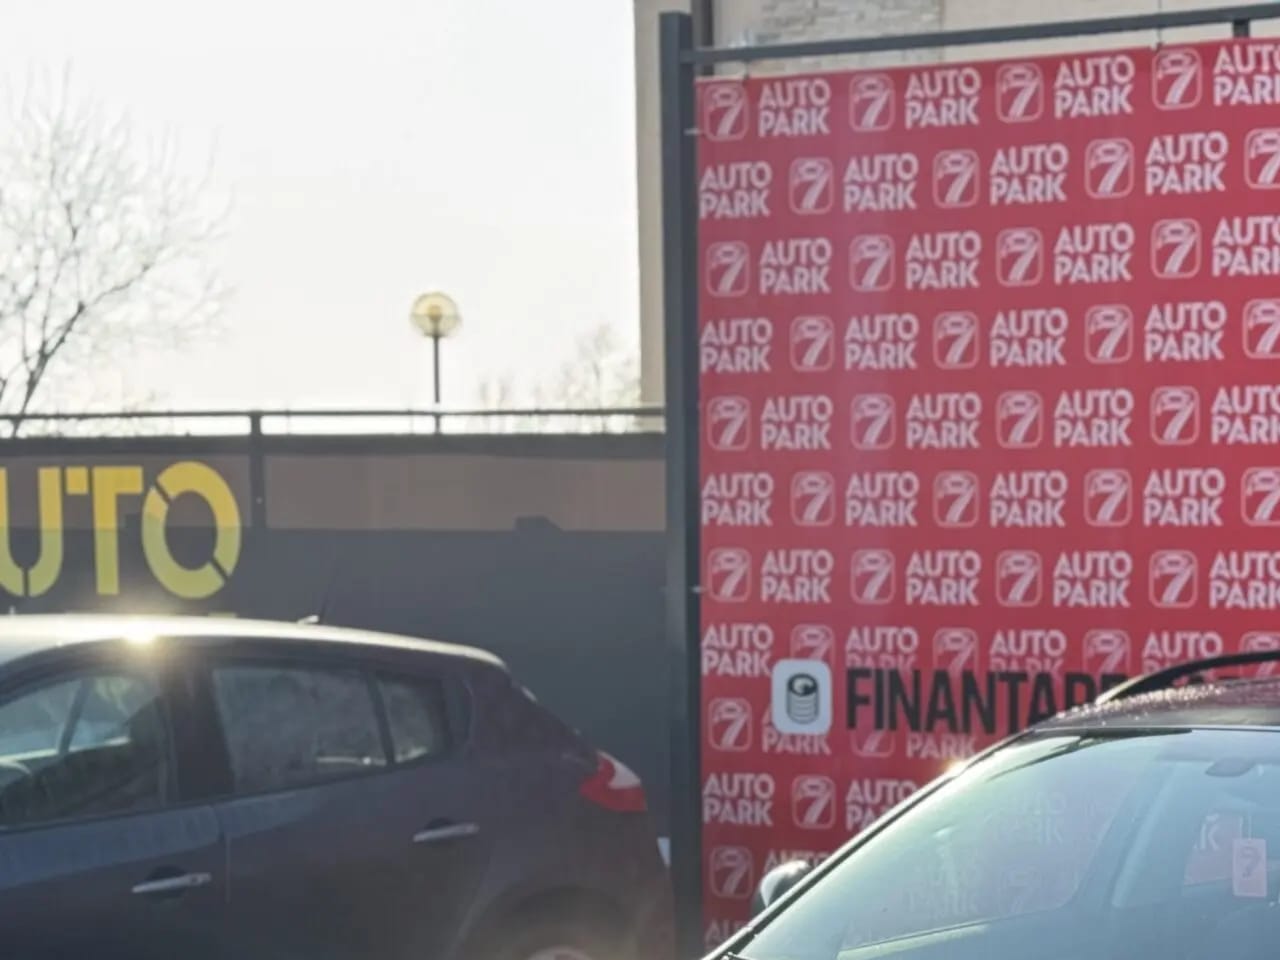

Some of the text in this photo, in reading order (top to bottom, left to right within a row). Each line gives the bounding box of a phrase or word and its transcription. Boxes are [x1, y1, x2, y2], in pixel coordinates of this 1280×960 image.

[904, 68, 980, 100] AUTO
[1054, 55, 1134, 89] AUTO
[757, 79, 830, 109] AUTO
[1055, 84, 1132, 118] PARK
[759, 106, 829, 137] PARK
[906, 96, 978, 128] PARK
[990, 143, 1068, 176] AUTO
[1146, 132, 1228, 165] AUTO
[699, 161, 772, 192] AUTO
[844, 153, 918, 184] AUTO
[1146, 161, 1225, 194] PARK
[844, 180, 916, 212] PARK
[990, 173, 1066, 205] PARK
[699, 189, 770, 219] PARK
[760, 238, 832, 267] AUTO
[906, 231, 981, 262] AUTO
[1054, 223, 1134, 255] AUTO
[760, 265, 830, 294] PARK
[906, 259, 979, 289] PARK
[1055, 252, 1131, 284] PARK
[845, 313, 919, 343] AUTO
[991, 308, 1068, 338] AUTO
[1145, 301, 1226, 332] AUTO
[700, 318, 772, 346] AUTO
[1145, 330, 1224, 361] PARK
[700, 345, 770, 373] PARK
[845, 341, 916, 370] PARK
[990, 336, 1065, 366] PARK
[761, 395, 833, 423] AUTO
[906, 392, 981, 421] AUTO
[1055, 389, 1133, 419] AUTO
[761, 421, 830, 449] PARK
[907, 419, 979, 448] PARK
[1055, 417, 1131, 446] PARK
[702, 472, 773, 499] AUTO
[846, 472, 919, 499] AUTO
[990, 471, 1067, 499] AUTO
[1144, 468, 1225, 497] AUTO
[702, 499, 771, 525] PARK
[846, 499, 917, 526] PARK
[990, 499, 1065, 526] PARK
[1144, 497, 1222, 526] PARK
[762, 549, 833, 576] AUTO
[906, 550, 981, 577] AUTO
[1054, 551, 1132, 579] AUTO
[761, 576, 830, 602] PARK
[906, 577, 978, 605] PARK
[1054, 579, 1129, 607] PARK
[702, 624, 773, 650] AUTO
[846, 627, 918, 654] AUTO
[990, 630, 1067, 657] AUTO
[1142, 632, 1223, 660] AUTO
[702, 650, 773, 677] PARK
[703, 773, 774, 799] AUTO
[703, 797, 772, 826] PARK
